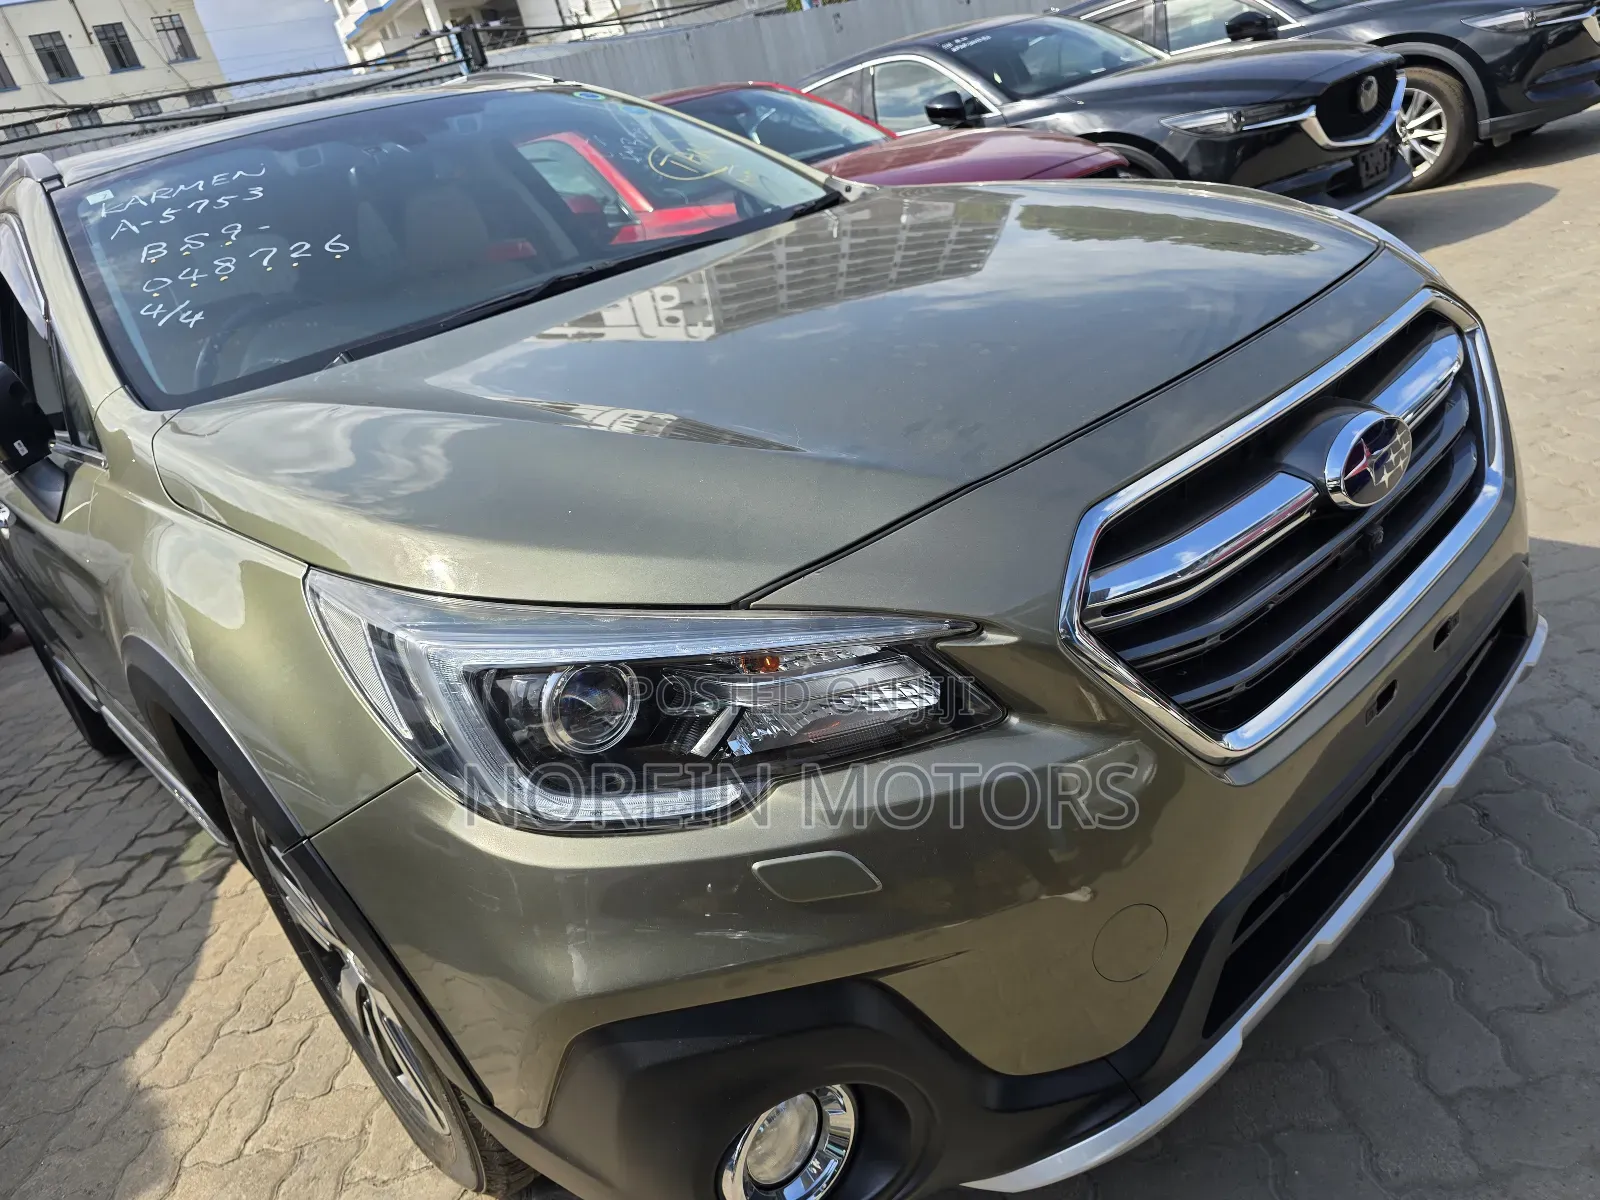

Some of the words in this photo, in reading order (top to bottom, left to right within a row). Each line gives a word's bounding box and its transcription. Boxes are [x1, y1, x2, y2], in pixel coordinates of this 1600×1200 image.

[101, 163, 266, 218] KARMEN
[110, 186, 264, 240] A-5753
[140, 300, 205, 328] 4/4
